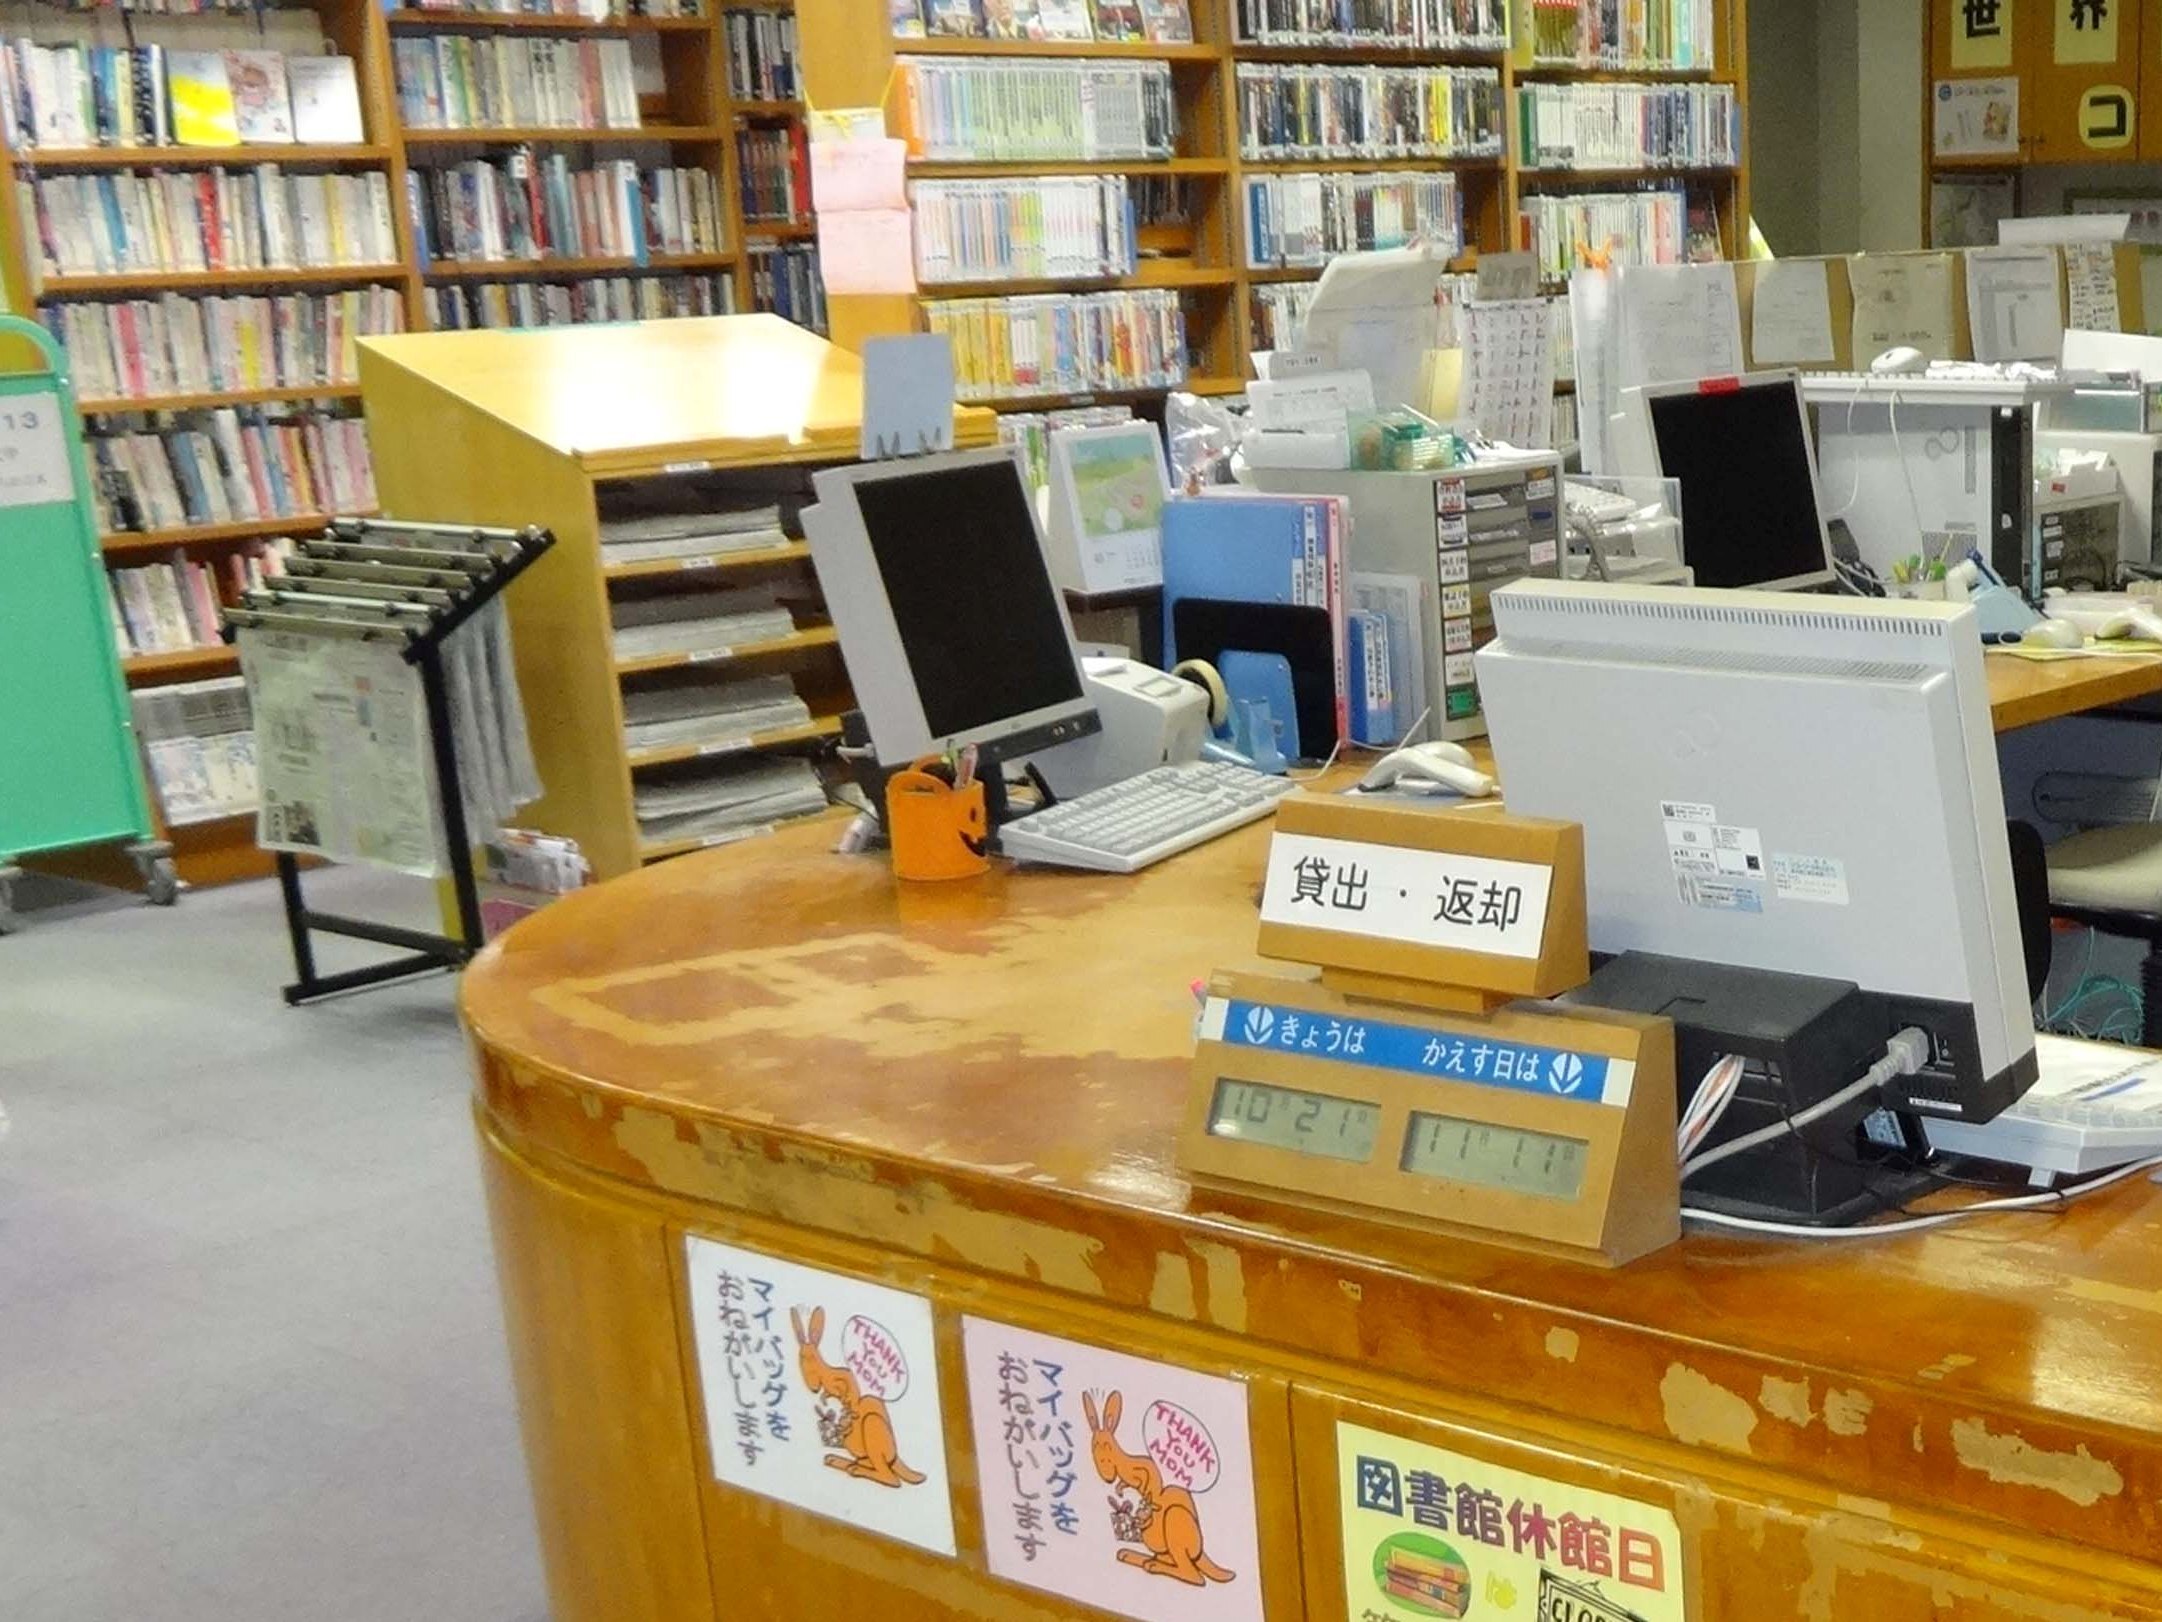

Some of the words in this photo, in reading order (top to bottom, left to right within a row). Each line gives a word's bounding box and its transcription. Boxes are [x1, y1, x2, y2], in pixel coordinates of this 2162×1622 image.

[2088, 95, 2127, 138] コ
[1281, 1014, 1366, 1054] きょうは
[1422, 1037, 1540, 1082] かえす日は
[717, 1270, 764, 1466] おねがいします
[748, 1277, 792, 1441] マイバッグを
[847, 1350, 885, 1396] MOM
[854, 1319, 905, 1384] THANK
[998, 1351, 1047, 1561] おねがいします
[1033, 1359, 1079, 1535] マイバッグを
[1150, 1438, 1193, 1487] MOM
[1155, 1402, 1215, 1473] THANK
[1356, 1454, 1665, 1592] 図書館休館日
